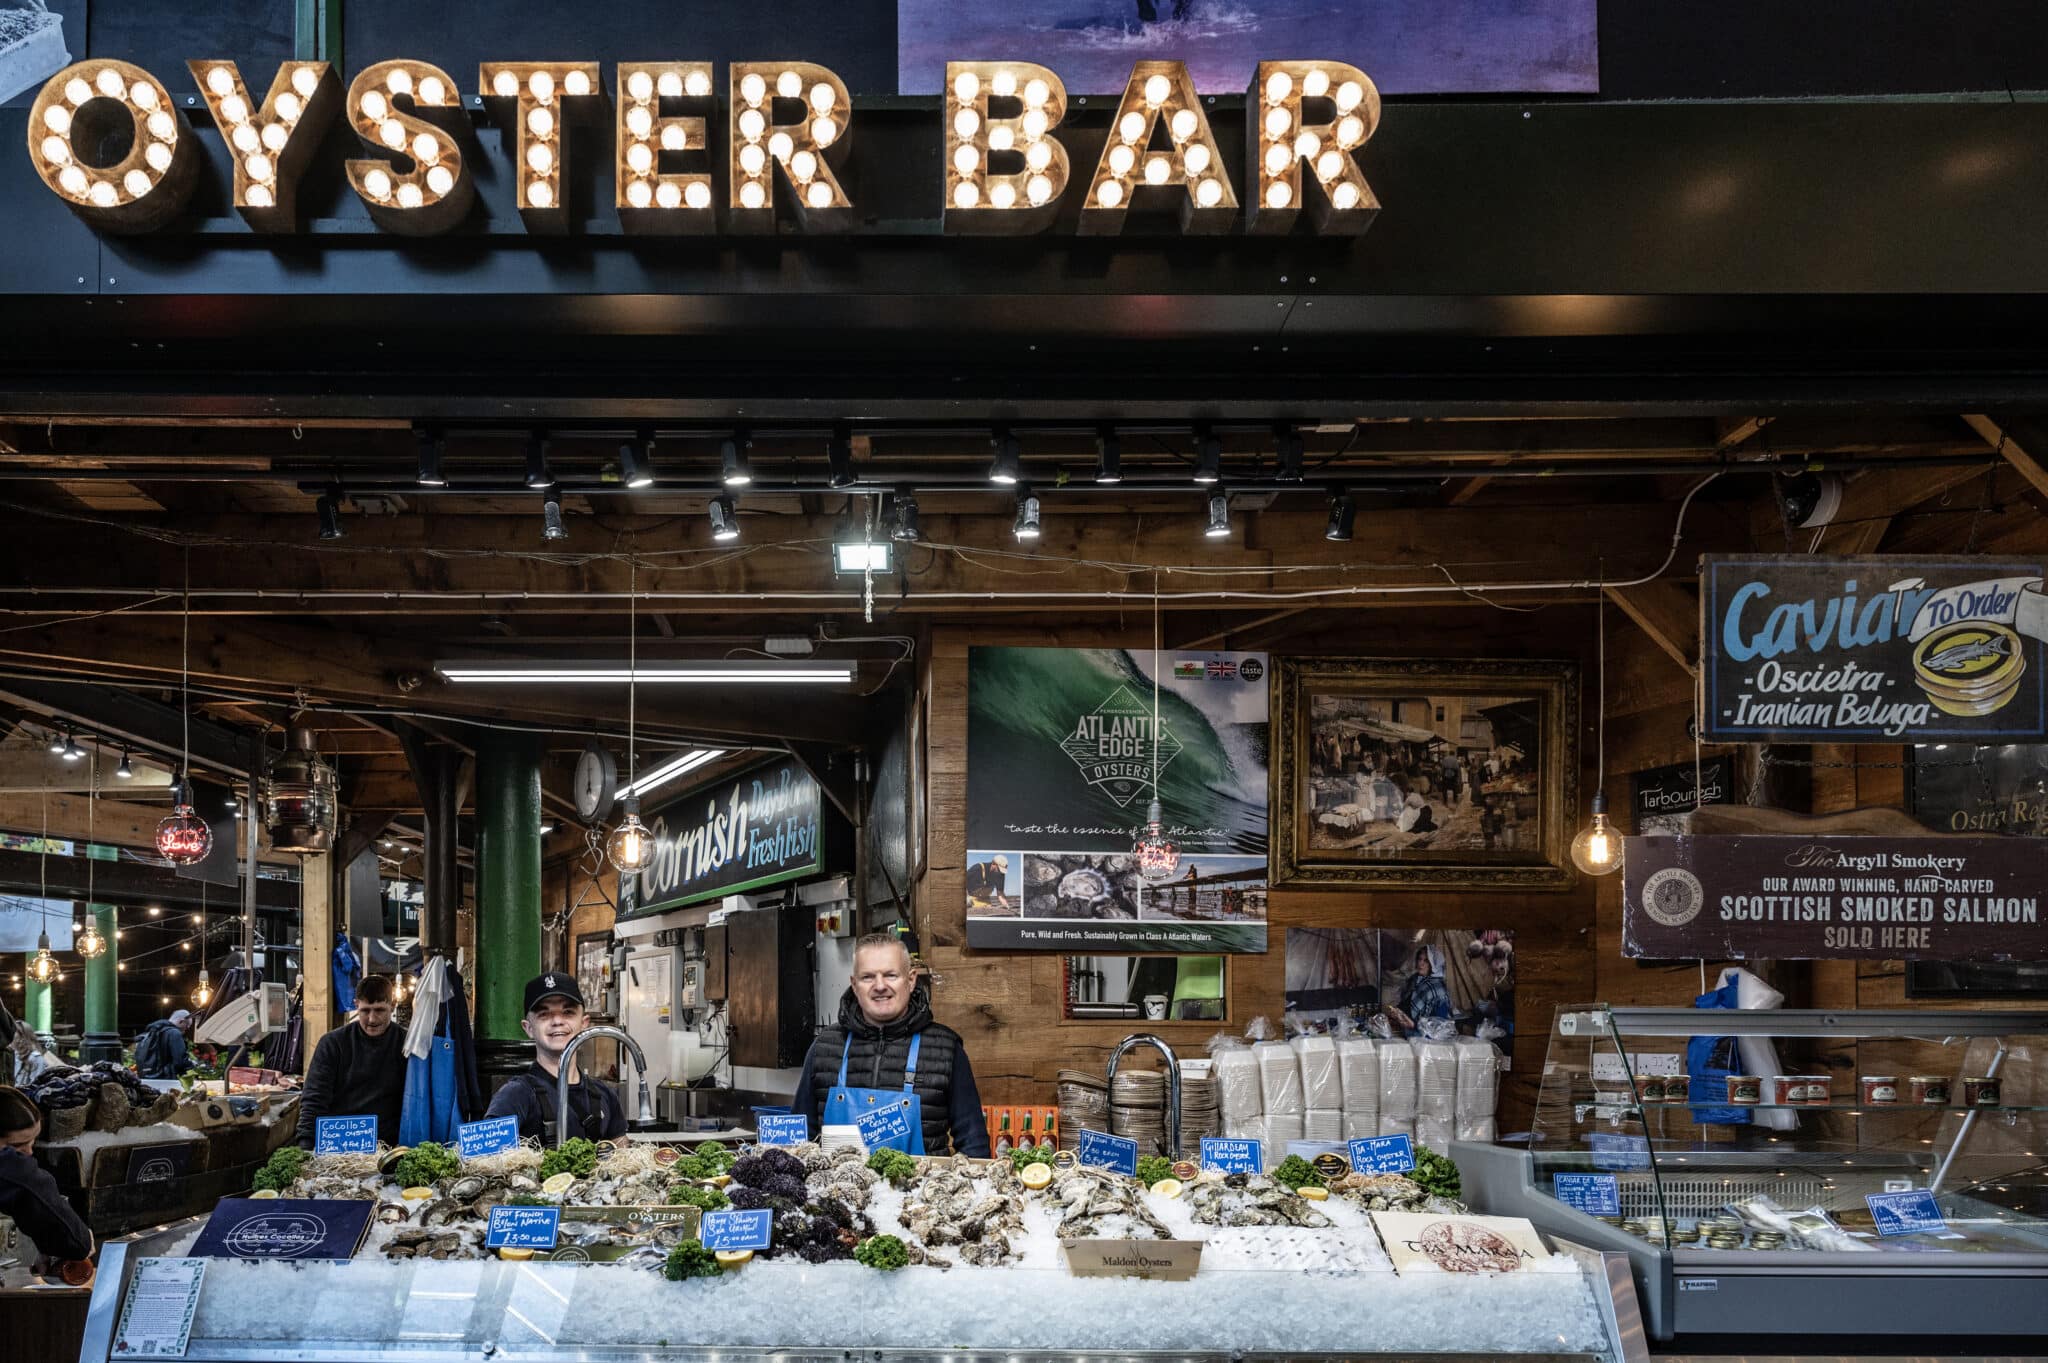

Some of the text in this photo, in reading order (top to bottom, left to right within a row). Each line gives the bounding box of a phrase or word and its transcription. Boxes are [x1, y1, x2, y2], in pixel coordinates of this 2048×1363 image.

[27, 59, 1382, 212] OYSTER BAR
[1927, 583, 2018, 627] To Order
[1723, 579, 1936, 662] Caviar
[1075, 715, 1167, 741] ATLANTIC
[1098, 738, 1145, 758] EDGE
[1094, 763, 1151, 779] OYSTERS
[161, 833, 201, 851] Love
[641, 783, 748, 901] Cornish
[747, 811, 817, 869] Fresh Fish
[1045, 824, 1069, 833] the
[1073, 826, 1125, 836] essence
[1129, 826, 1139, 839] of
[1836, 853, 1888, 872] Argyll
[1891, 853, 1966, 877] Smokery
[1763, 878, 1994, 894] OUR AWARD WINNING, HAND-CARVED
[1720, 896, 2038, 924] SCOTTISH SMOKED SALMON
[1038, 930, 1052, 939] Wild
[1052, 931, 1064, 939] and
[1084, 931, 1117, 941] Sustainably
[1119, 932, 1138, 940] Grown
[1145, 932, 1162, 940] Class
[1168, 932, 1190, 940] Atlantic
[1824, 926, 1931, 949] SOLD HERE
[628, 1212, 685, 1221] OYSTERS
[1102, 1256, 1172, 1269] Maldon Oysters
